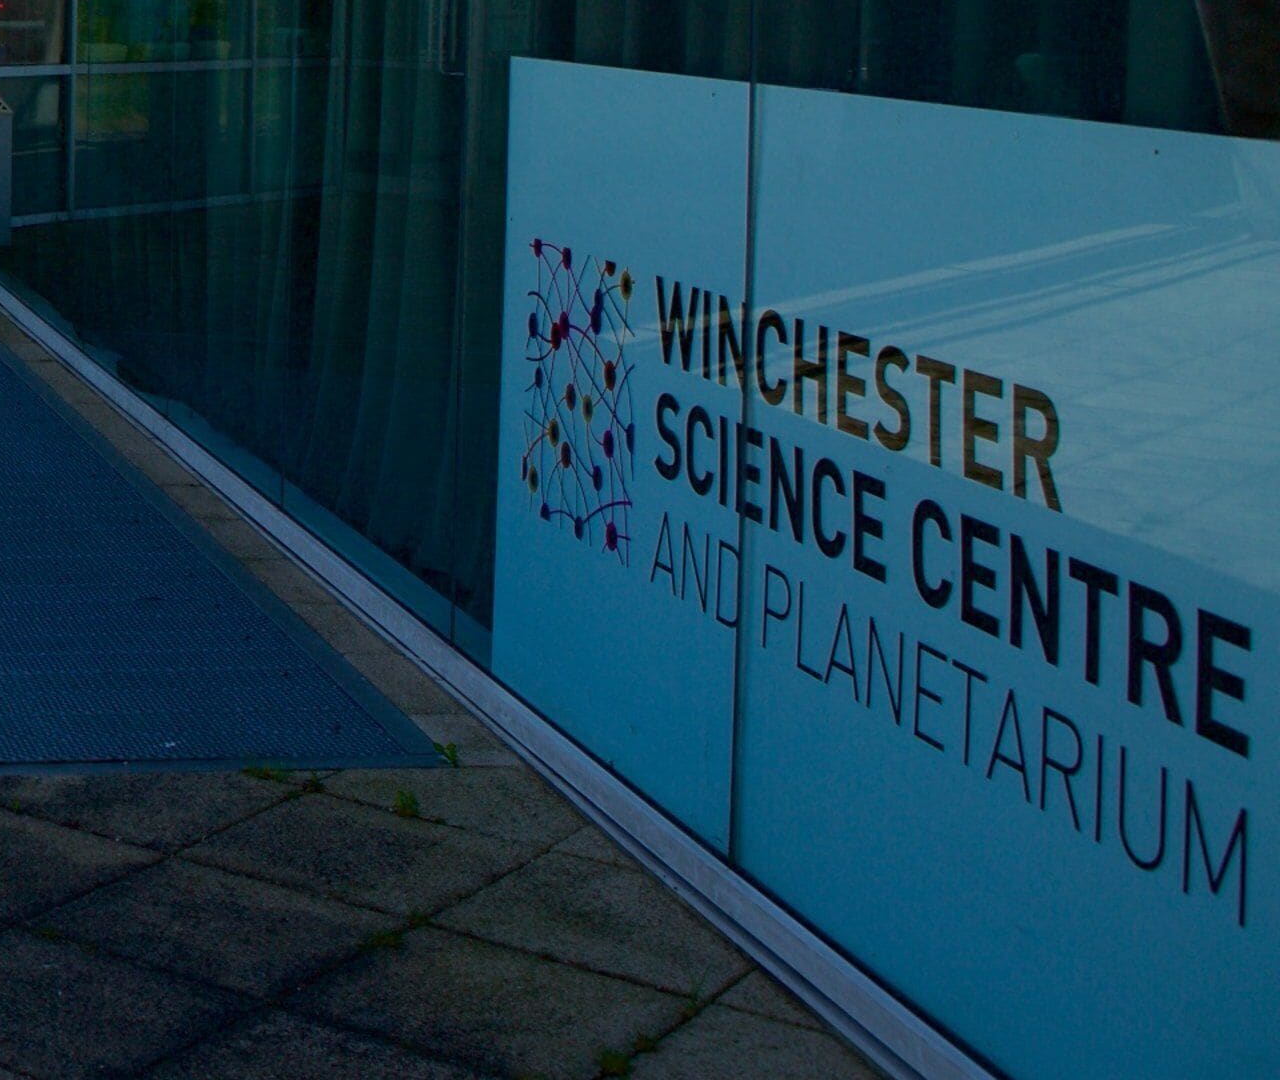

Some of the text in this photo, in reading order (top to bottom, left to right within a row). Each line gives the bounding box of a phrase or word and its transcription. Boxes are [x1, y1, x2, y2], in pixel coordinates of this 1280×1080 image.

[654, 392, 1252, 759] SCIENCE CENTRE
[655, 275, 1063, 513] WINCHESTER
[650, 511, 1248, 928] AND PLANETARIUM
